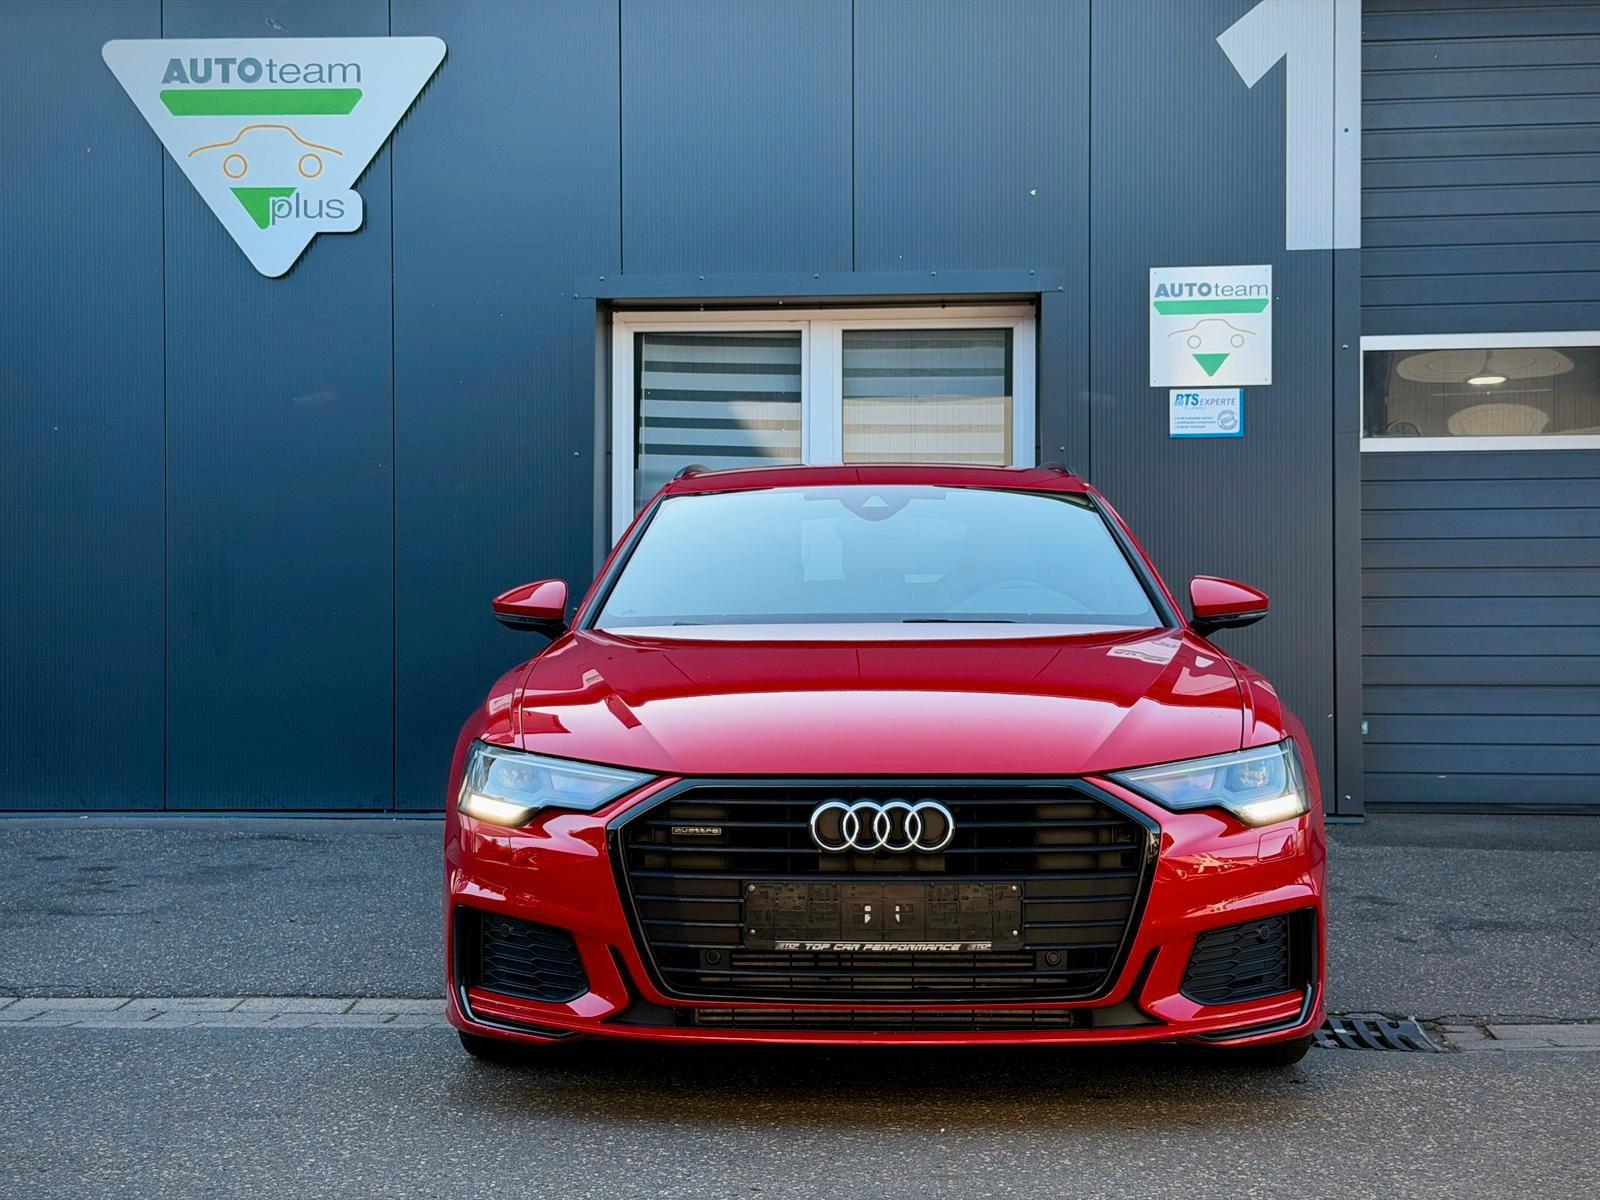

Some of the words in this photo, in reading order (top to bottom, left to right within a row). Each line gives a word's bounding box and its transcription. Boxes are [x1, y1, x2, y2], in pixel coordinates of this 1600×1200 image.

[161, 57, 362, 85] AUTOteam
[1216, 0, 1361, 250] 1
[271, 192, 345, 225] plus
[1154, 282, 1268, 298] AUTOteam
[1200, 398, 1236, 406] EXPERTE
[805, 943, 831, 951] TOP
[833, 943, 860, 951] CAR
[863, 943, 962, 951] PERFORMANCE
